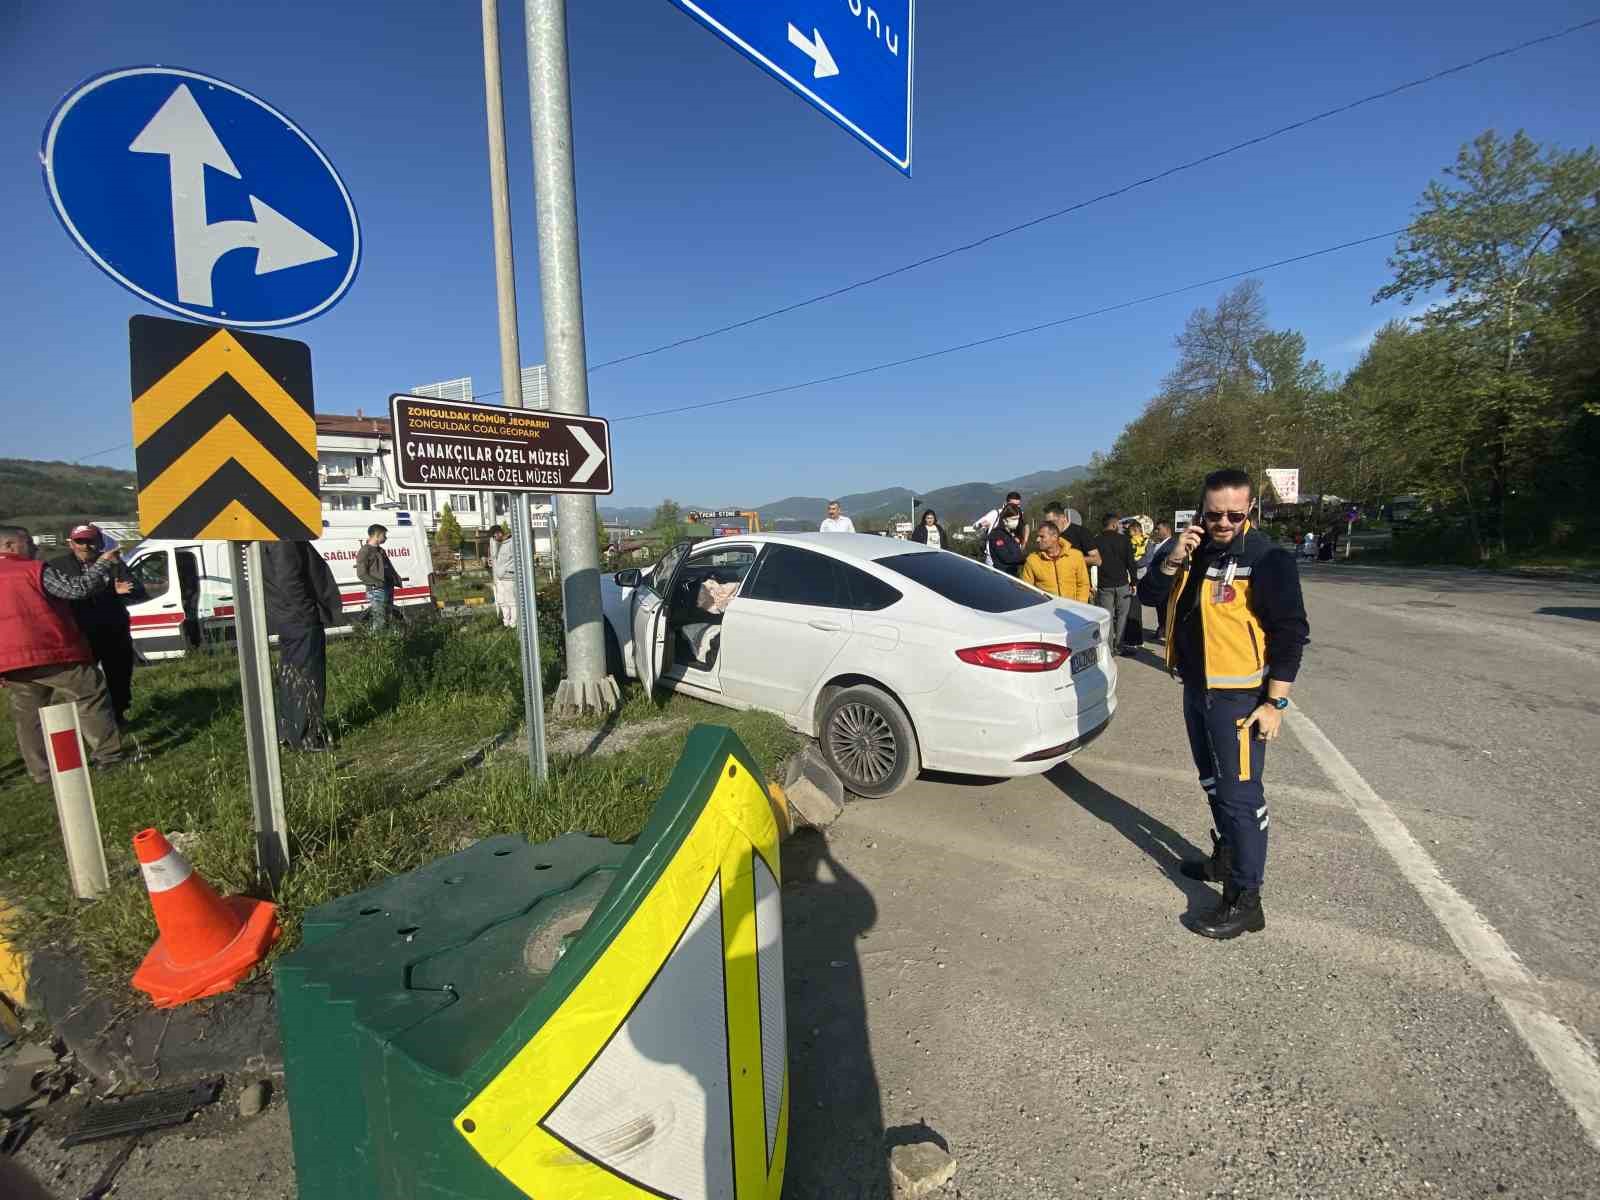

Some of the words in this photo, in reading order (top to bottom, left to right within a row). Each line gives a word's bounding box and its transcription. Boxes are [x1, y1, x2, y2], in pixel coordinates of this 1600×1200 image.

[408, 407, 470, 420] ZONGULDAK
[472, 412, 506, 424] KÖMÜR
[508, 417, 550, 429] JEOPARKI
[408, 418, 471, 432] ZONGULDAK
[473, 425, 498, 434] COAL
[499, 427, 540, 438] GEOPARK
[406, 441, 492, 463] ÇANAKÇILAR
[495, 445, 526, 464] ÖZEL
[528, 449, 570, 467] MÜZESİ
[420, 464, 495, 484] ÇANAKÇILAR
[497, 465, 524, 483] ÖZEL
[526, 467, 562, 485] MÜZESİ
